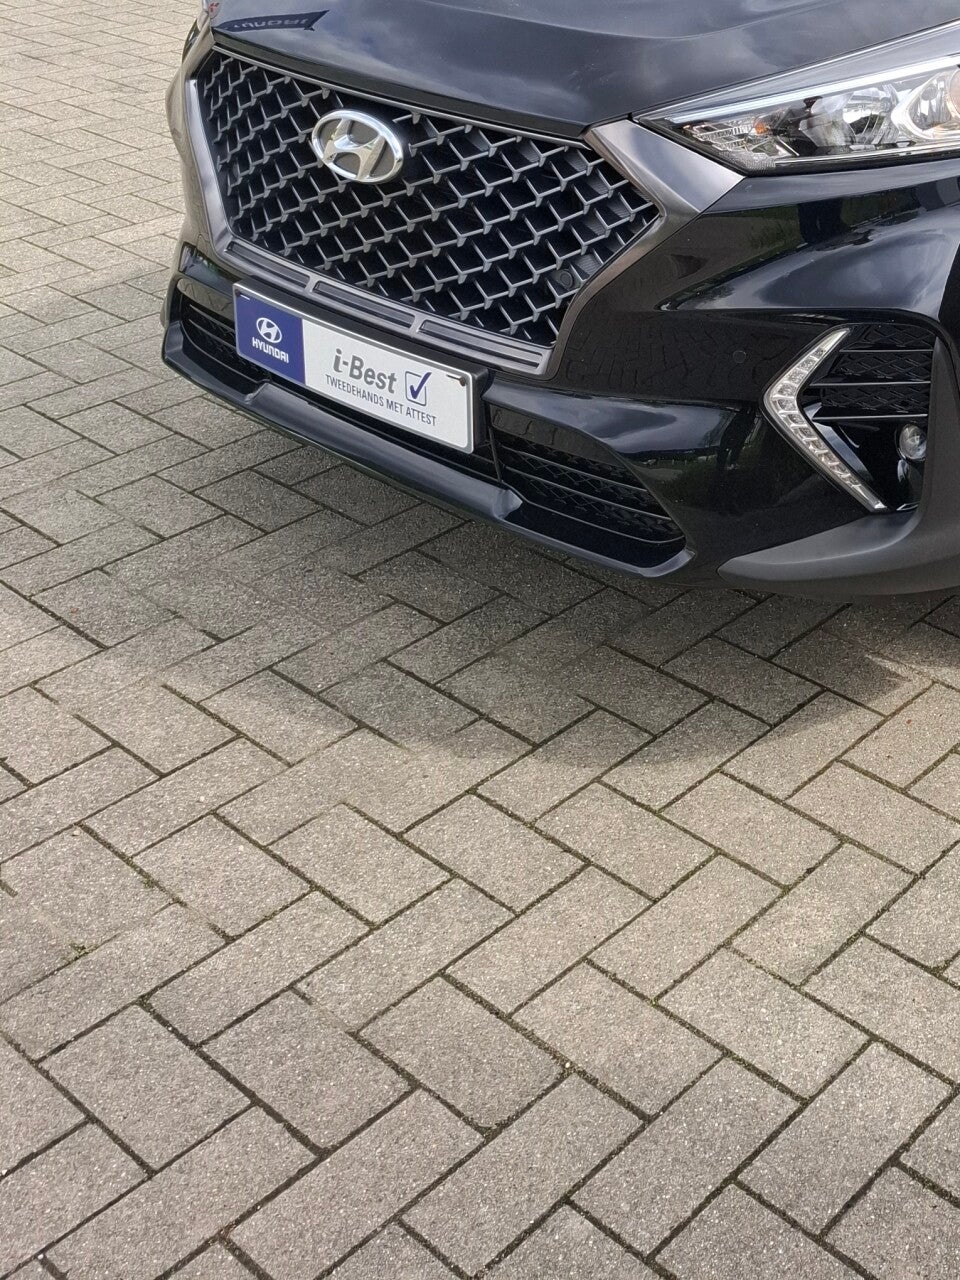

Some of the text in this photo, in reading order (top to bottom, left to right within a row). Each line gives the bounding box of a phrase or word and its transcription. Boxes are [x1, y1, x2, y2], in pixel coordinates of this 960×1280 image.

[251, 336, 289, 364] HYUNDAI
[332, 348, 398, 394] i-Best
[325, 373, 437, 427] TWEEDEHANDS MET ATTEST
